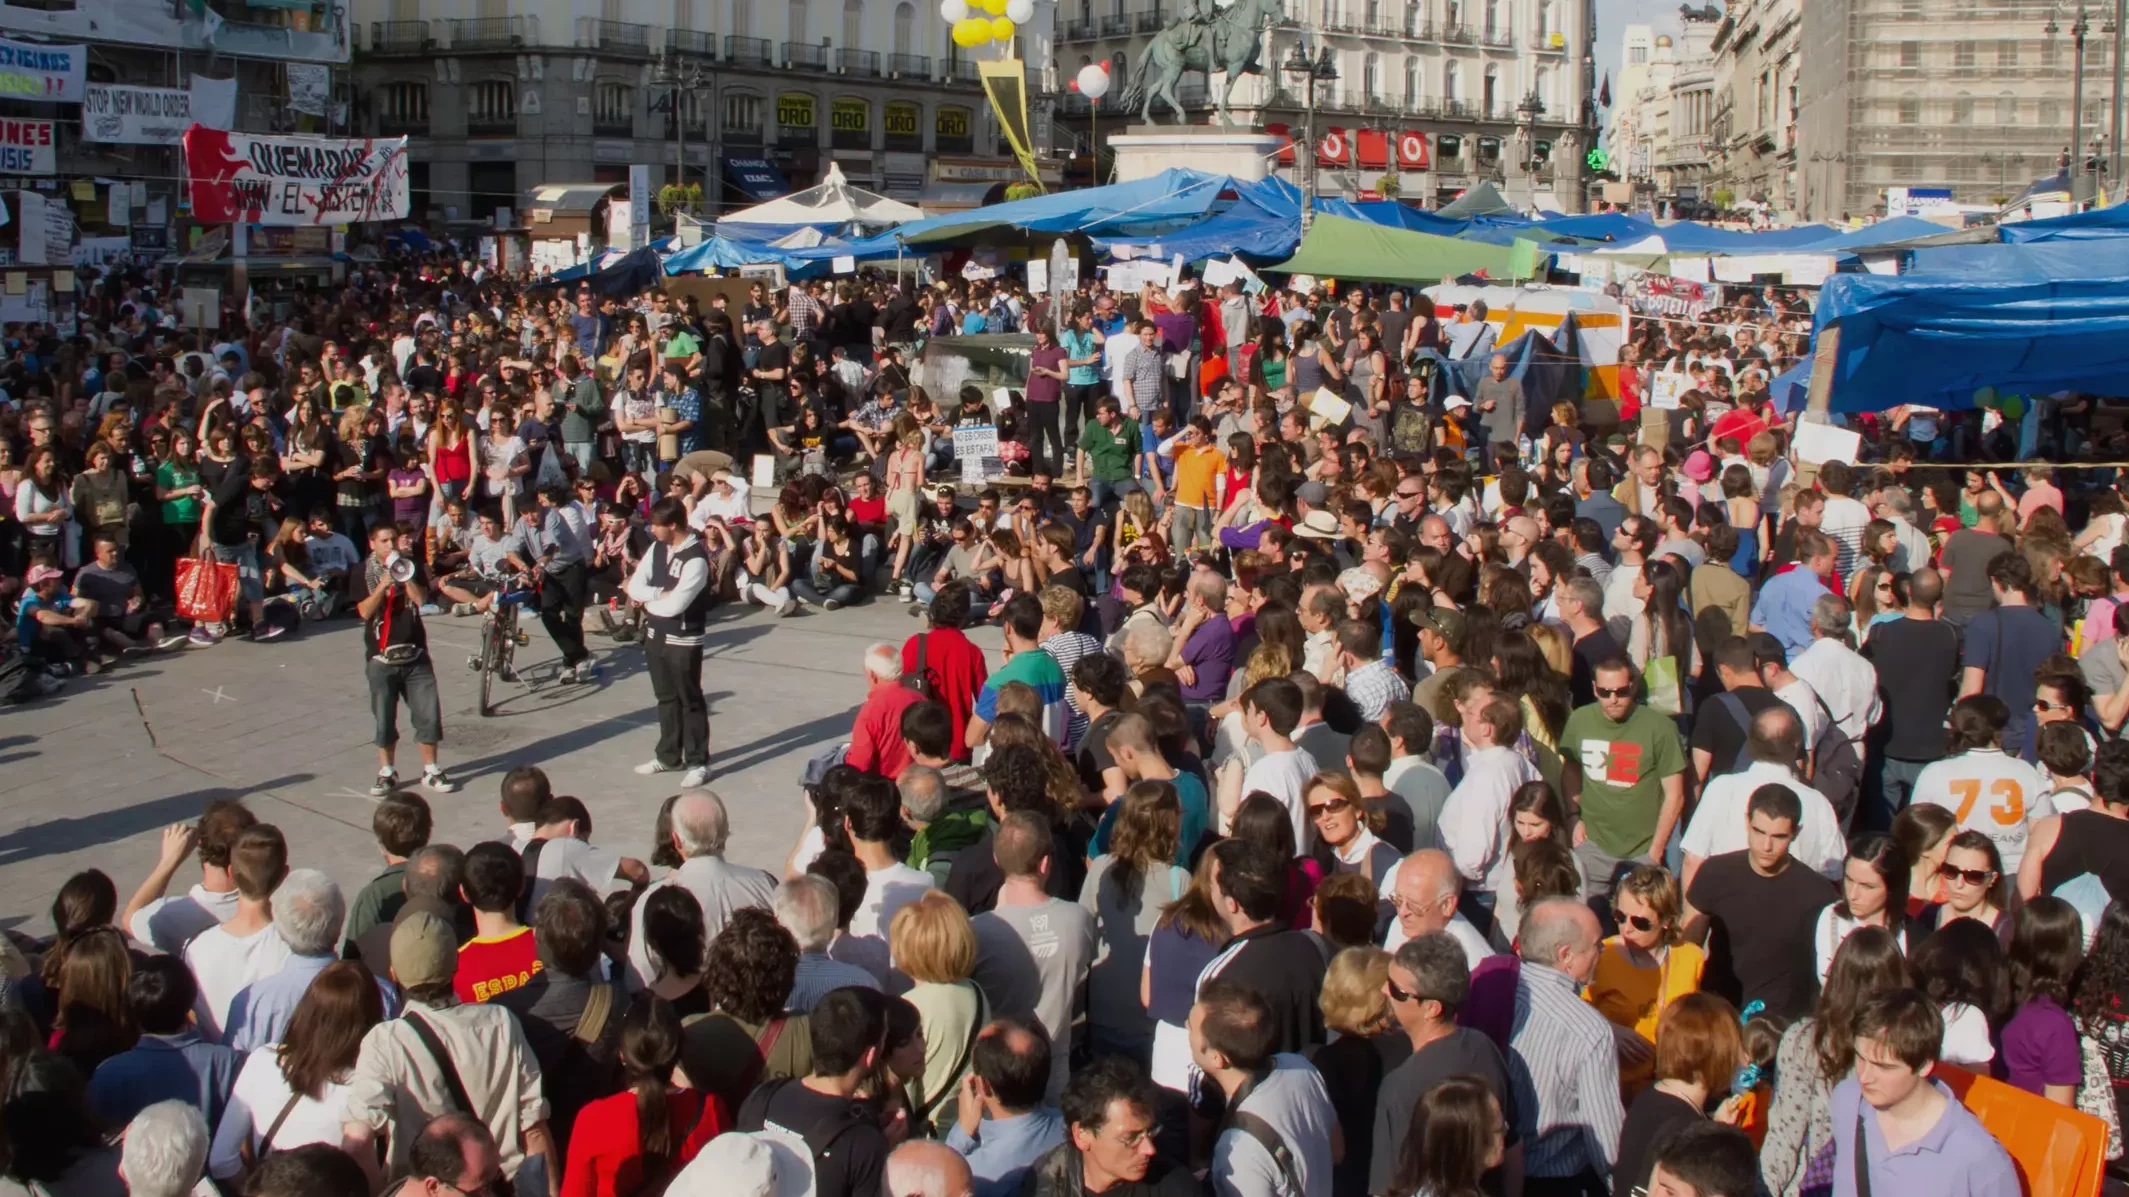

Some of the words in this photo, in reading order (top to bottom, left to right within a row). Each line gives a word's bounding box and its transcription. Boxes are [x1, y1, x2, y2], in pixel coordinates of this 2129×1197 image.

[85, 88, 109, 113] STOP
[111, 90, 133, 115] NEW
[134, 92, 162, 116] WORLD
[162, 94, 191, 118] ORDER
[777, 108, 812, 125] ORO
[832, 111, 866, 128] ORO
[884, 116, 916, 132] ORO
[936, 119, 967, 135] ORO
[0, 120, 51, 146] NES
[249, 141, 373, 178] QUEMADOS
[282, 181, 305, 214] EL
[955, 448, 966, 456] ES
[1949, 778, 2025, 825] 73
